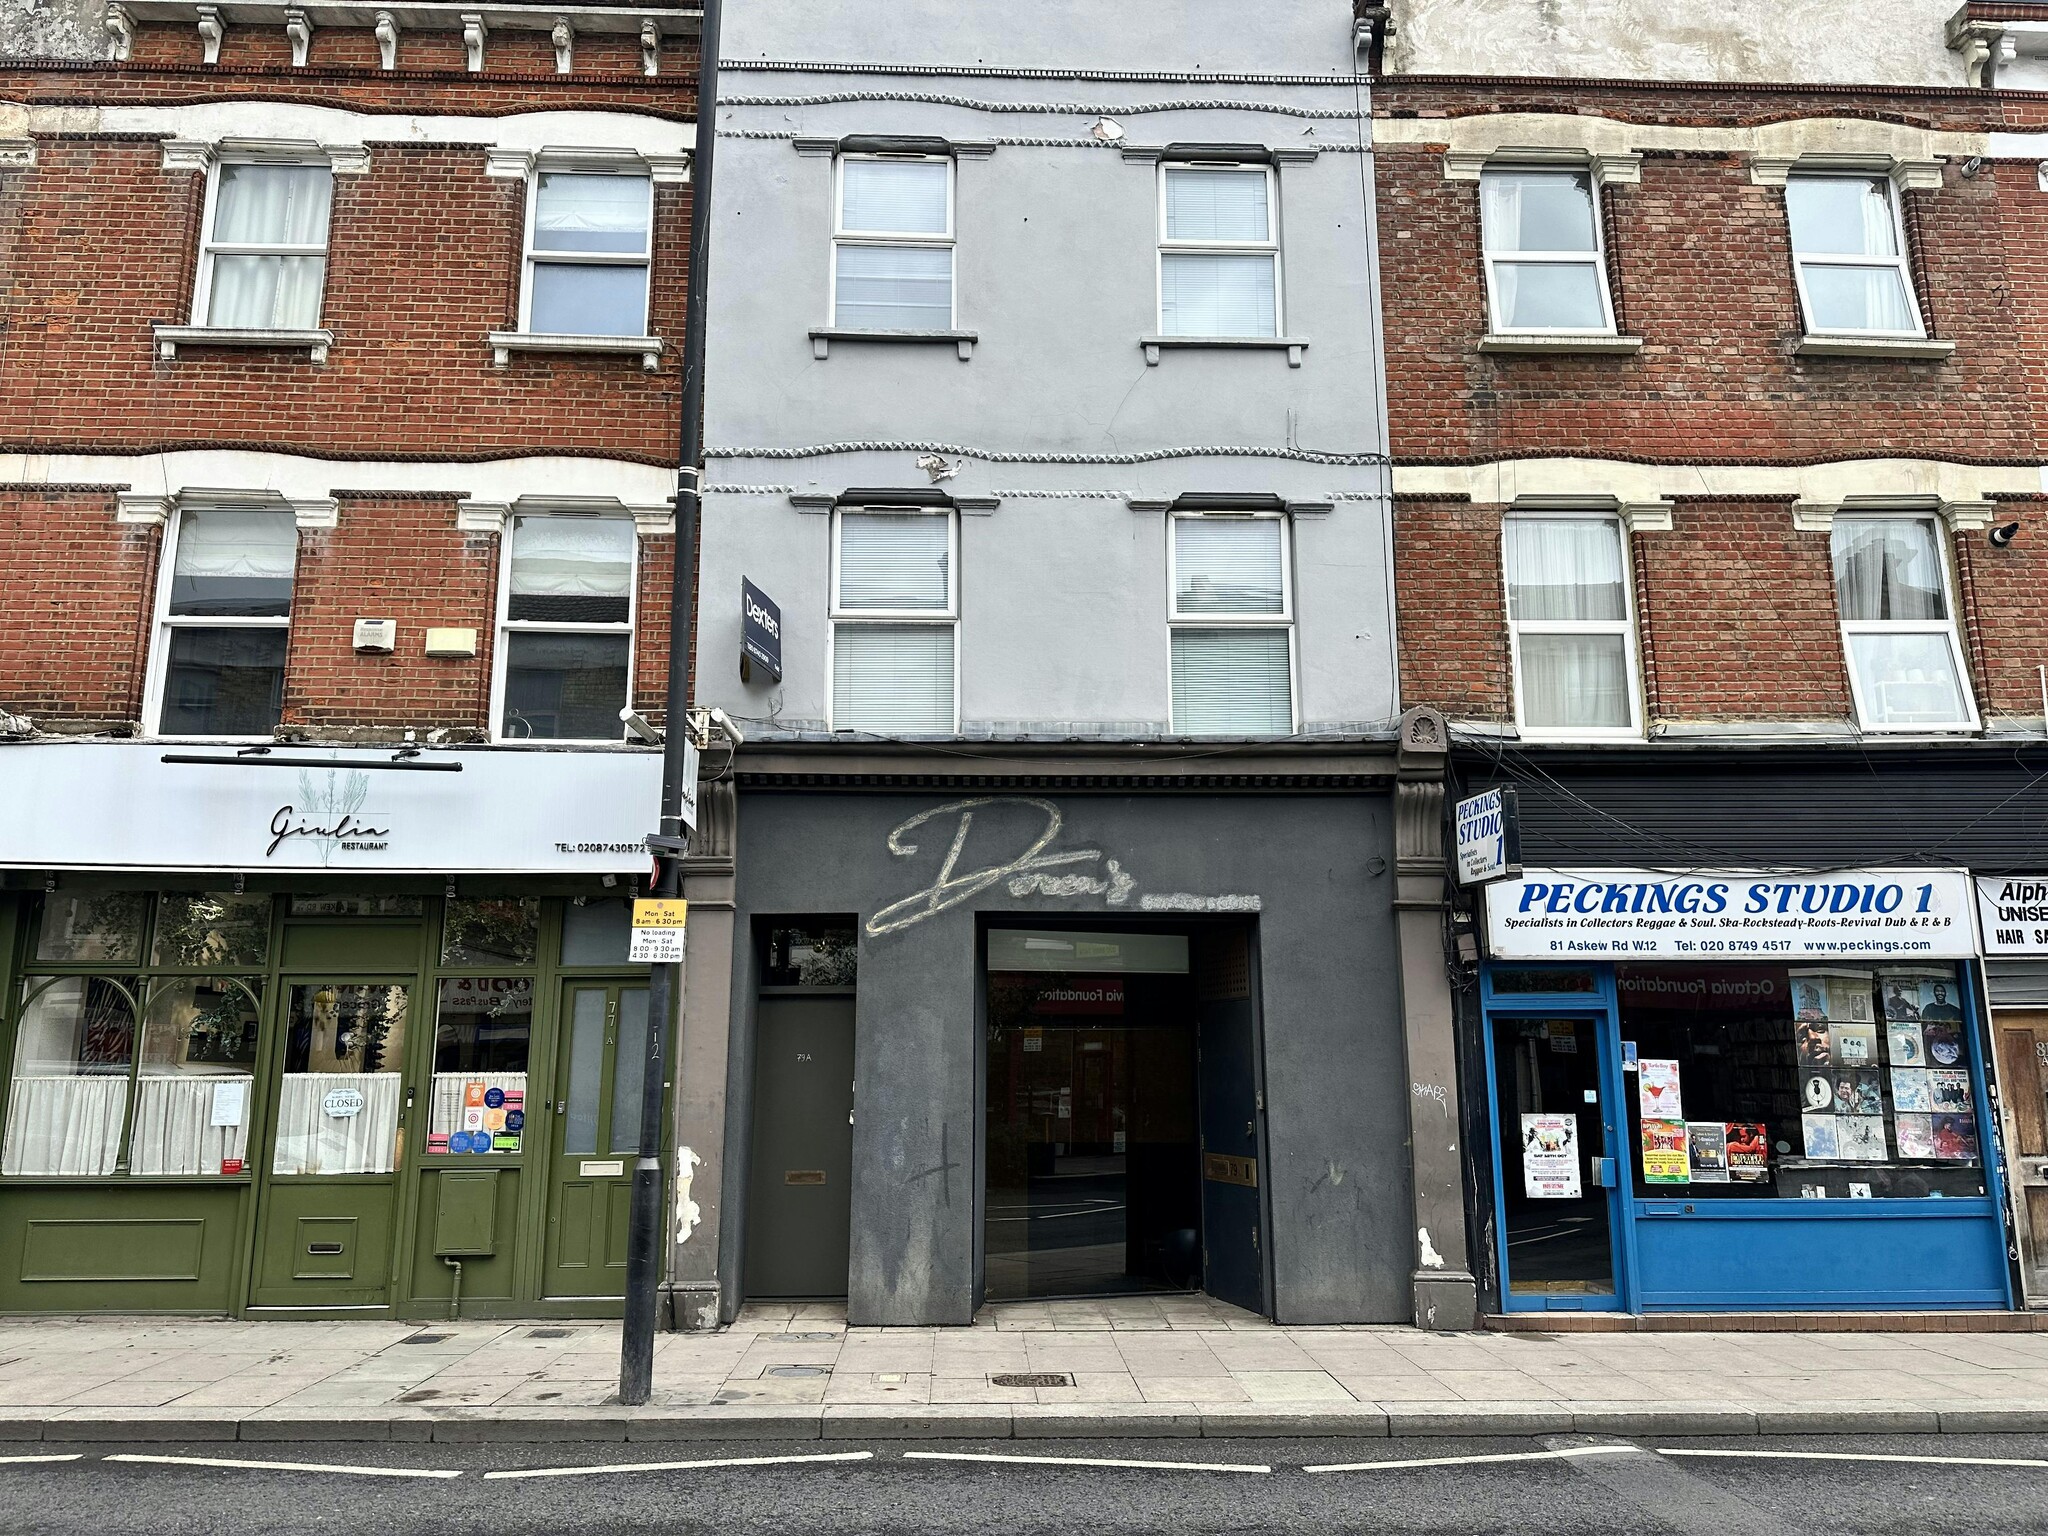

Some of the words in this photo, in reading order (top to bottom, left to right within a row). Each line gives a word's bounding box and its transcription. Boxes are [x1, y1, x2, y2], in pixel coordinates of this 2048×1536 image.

[746, 592, 779, 640] Dexters
[1458, 789, 1502, 821] PECKINGS
[266, 805, 390, 857] Giulia
[1458, 811, 1502, 845] STUDIO
[341, 842, 389, 850] RESTAURANT
[555, 843, 575, 852] TEL:
[1496, 834, 1504, 866] 1
[1518, 883, 1729, 914] PECKINGS
[1744, 883, 1904, 914] STUDIO
[1915, 883, 1933, 913] 1
[1998, 906, 2048, 921] UNISE
[1504, 917, 1564, 929] Specialists
[1566, 918, 1577, 928] in
[1580, 917, 1633, 928] Collectors
[1636, 918, 1676, 930] Reggae
[1678, 918, 1688, 928] &
[1690, 917, 1717, 928] Soul.
[1885, 917, 1906, 927] Dub
[1910, 918, 1919, 927] &
[1933, 918, 1942, 927] &
[1944, 918, 1951, 927] B
[1996, 929, 2024, 944] HAIR
[1550, 940, 1563, 951] 81
[1568, 940, 1608, 951] Askew
[1612, 940, 1628, 951] Rd
[1675, 940, 1697, 951] Tel:
[1700, 940, 1724, 951] 020
[1729, 940, 1757, 950] 8749
[1762, 940, 1791, 950] 4517
[1804, 939, 1931, 952] www.peckings.com
[324, 1098, 362, 1108] CLOSED
